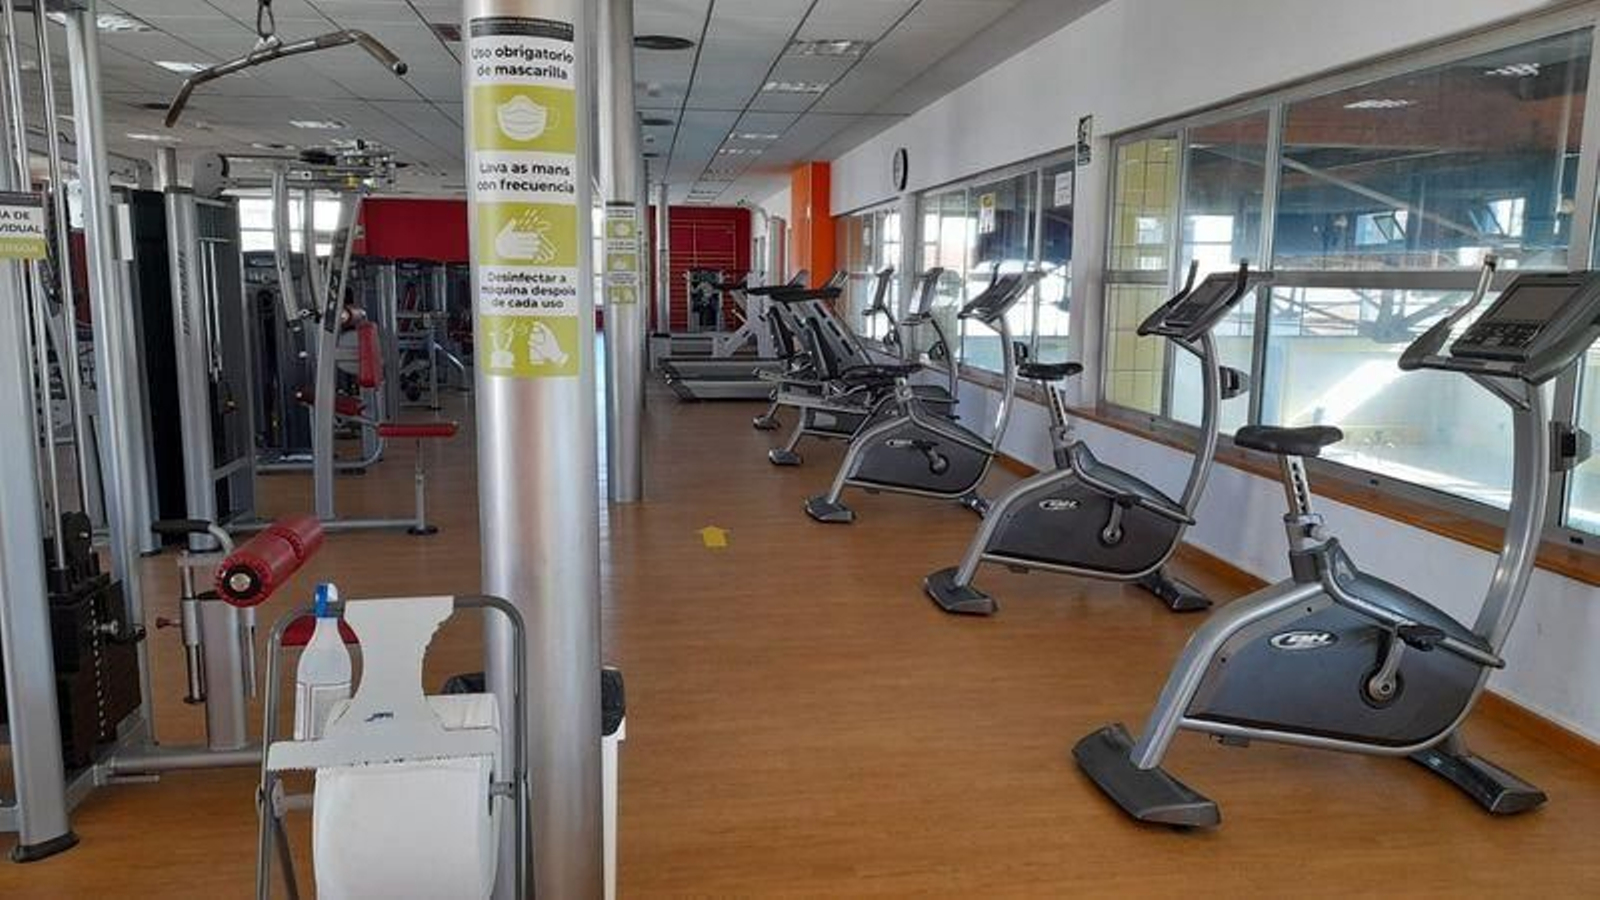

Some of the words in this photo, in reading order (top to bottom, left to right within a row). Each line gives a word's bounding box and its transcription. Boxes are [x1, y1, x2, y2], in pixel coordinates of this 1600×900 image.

[471, 48, 492, 59] Uso
[495, 44, 575, 64] obrigatorio
[477, 64, 492, 76] de
[495, 65, 568, 80] mascarilla
[479, 163, 508, 174] Lava
[511, 164, 528, 174] as
[532, 164, 571, 176] mans
[477, 181, 496, 191] con
[500, 178, 575, 194] frecuencia
[13, 211, 30, 220] DE
[487, 271, 557, 283] Desinfectar
[559, 274, 567, 282] a
[531, 285, 576, 296] despois
[491, 298, 505, 307] de
[508, 297, 538, 308] cada
[541, 299, 564, 308] uso
